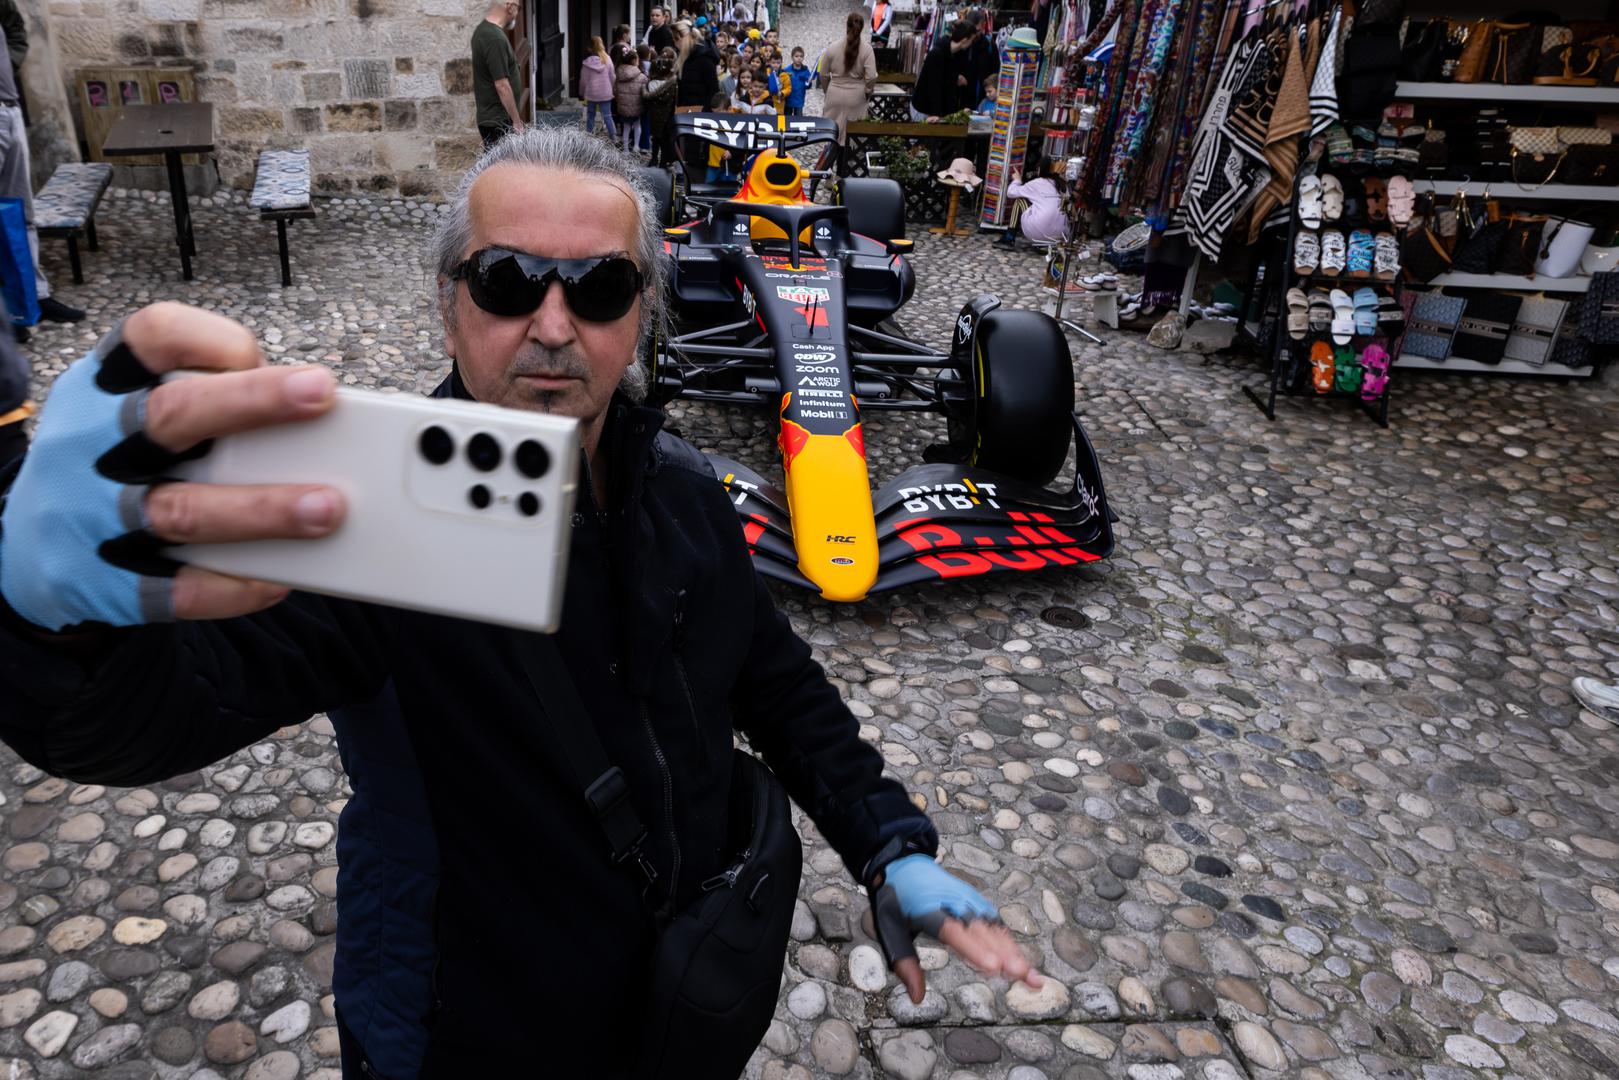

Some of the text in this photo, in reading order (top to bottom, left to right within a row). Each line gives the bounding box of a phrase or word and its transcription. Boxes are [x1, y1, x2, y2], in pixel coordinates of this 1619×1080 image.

[765, 272, 831, 280] ORACLE
[795, 364, 840, 374] zoom
[800, 409, 835, 419] Mobil
[898, 478, 1000, 513] BYBIT
[826, 534, 857, 544] HRC
[893, 511, 1103, 579] Bull
